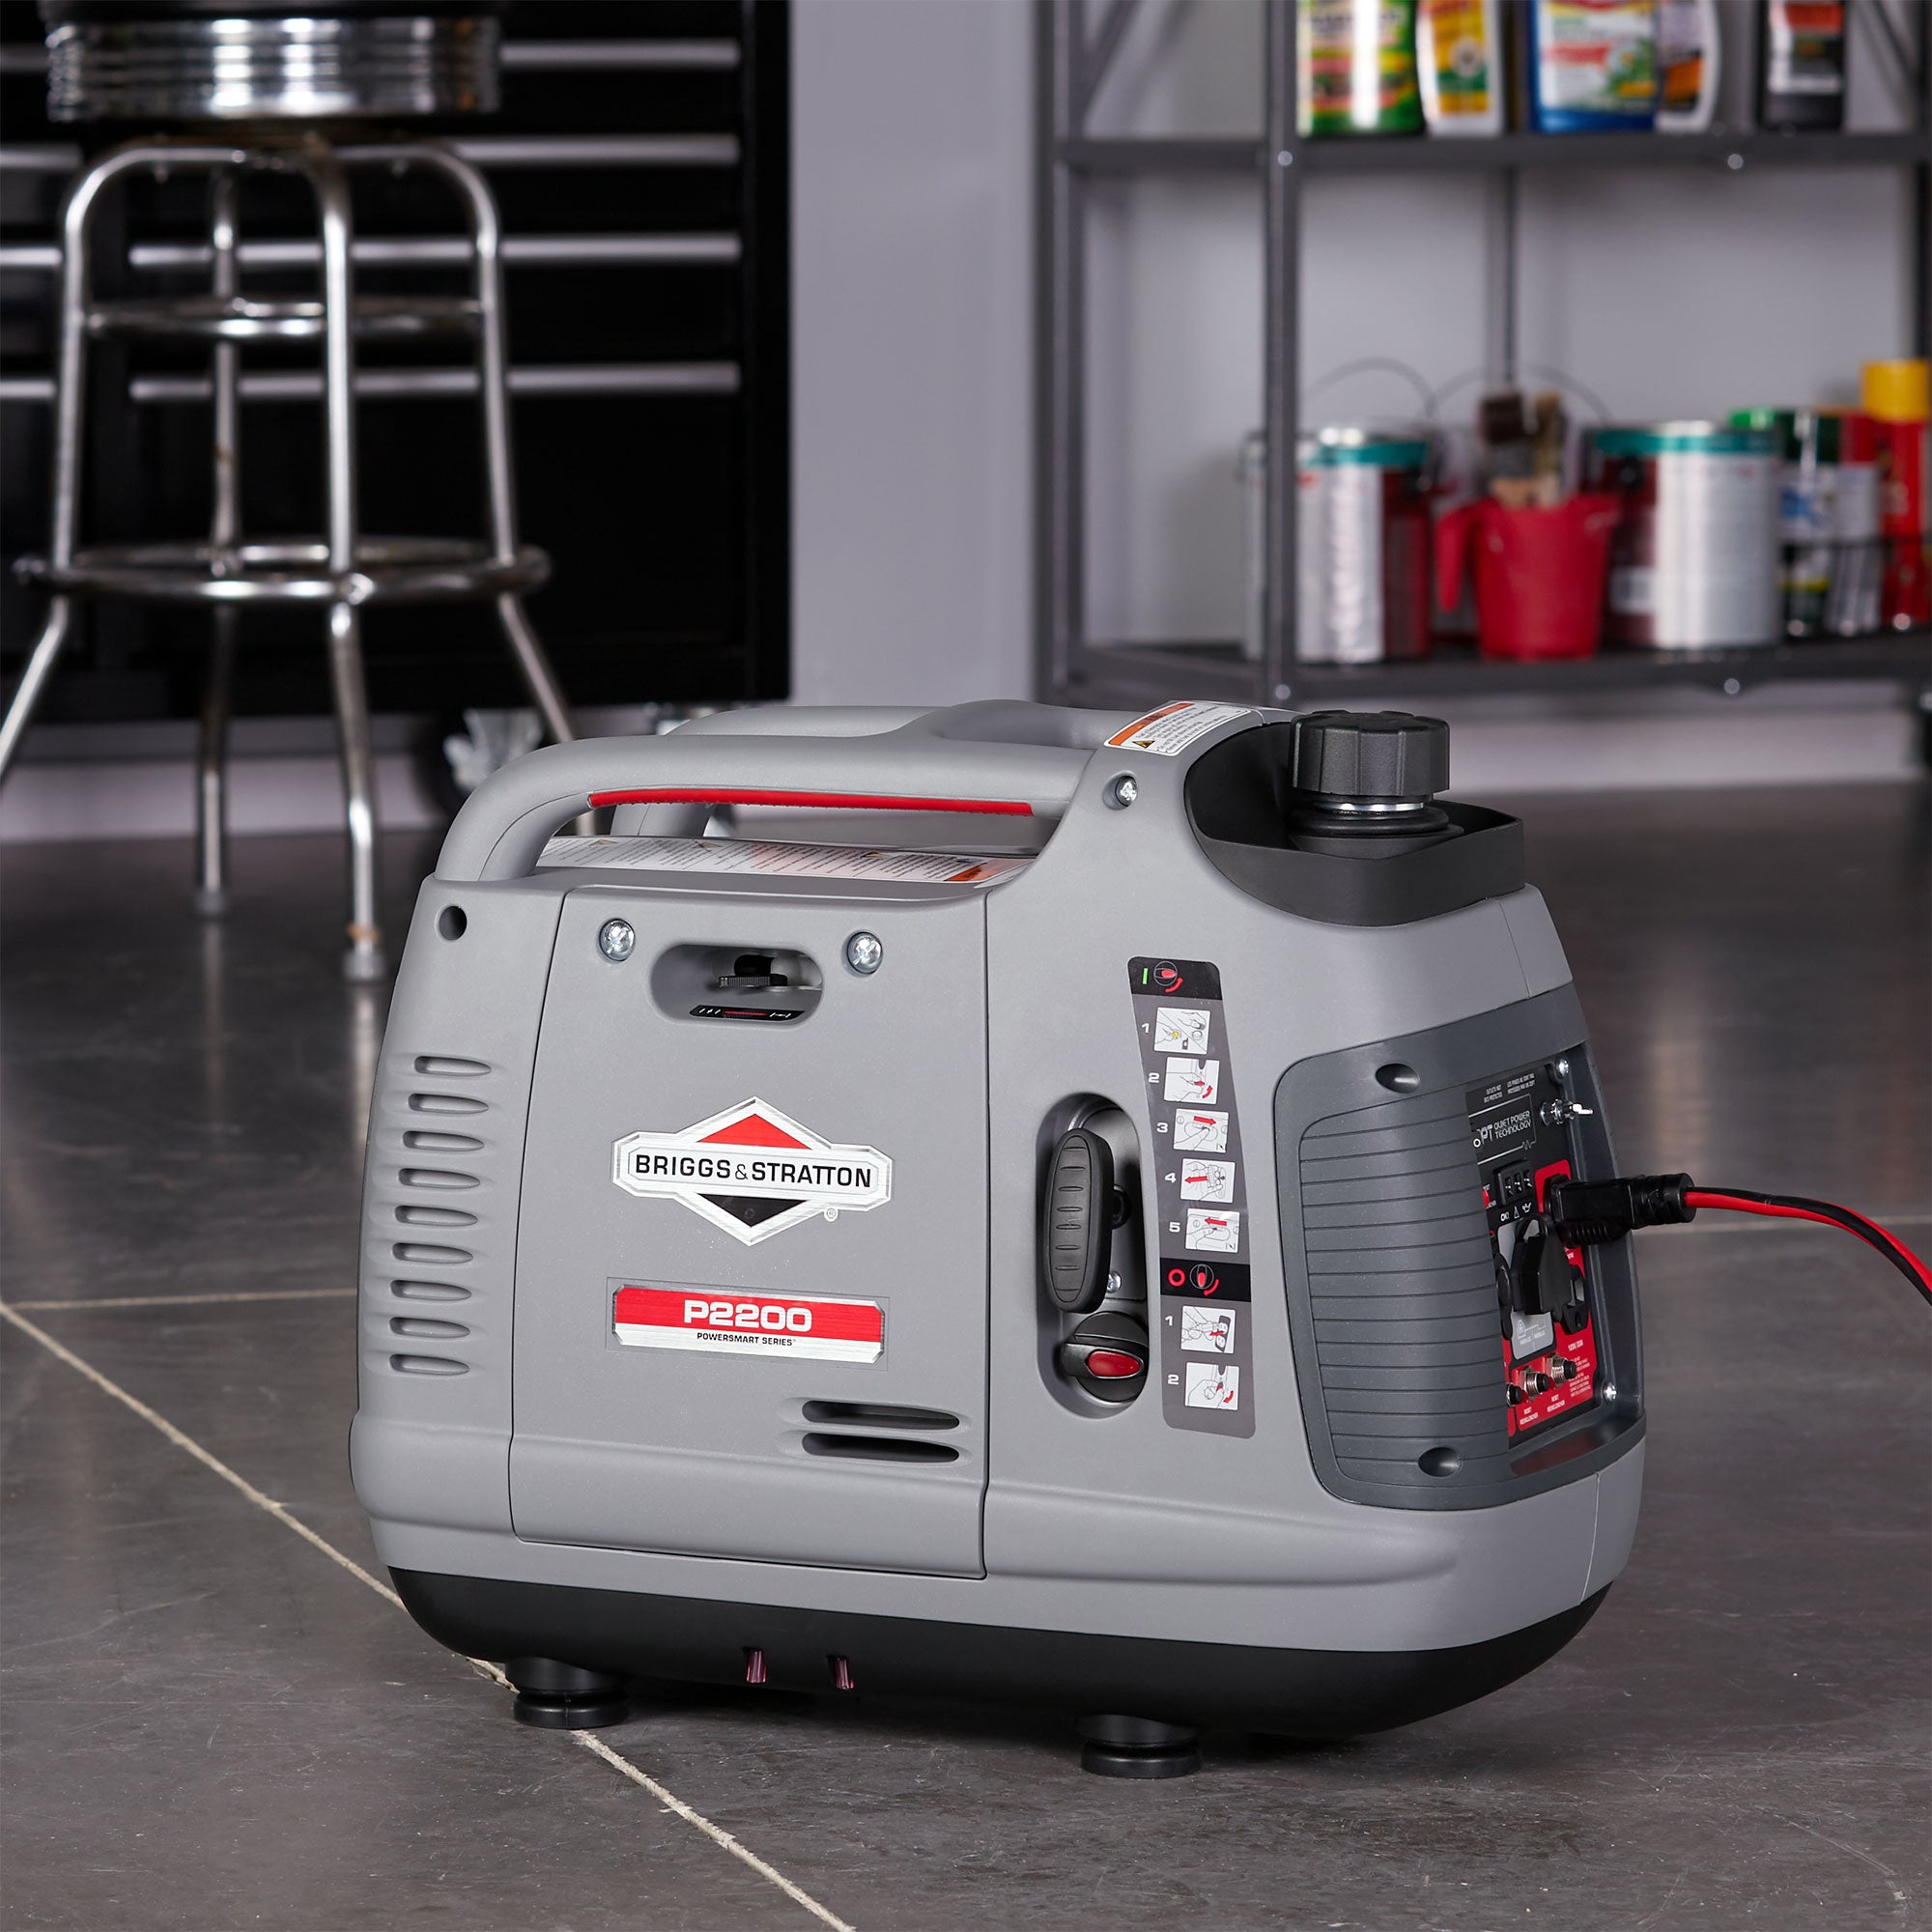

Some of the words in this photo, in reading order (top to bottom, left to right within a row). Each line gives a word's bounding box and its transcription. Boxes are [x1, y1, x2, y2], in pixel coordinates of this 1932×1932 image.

[1142, 1023, 1150, 1034] 1
[1148, 1072, 1159, 1084] 2
[1156, 1122, 1169, 1133] 3
[636, 1154, 731, 1179] BRIGGS
[752, 1162, 870, 1188] STRATTON
[1164, 1172, 1177, 1183] 4
[1169, 1222, 1180, 1233] 5
[683, 1299, 812, 1332] P2200
[1164, 1316, 1174, 1326] 1
[696, 1332, 759, 1345] POWERSMART
[1167, 1374, 1179, 1385] 2
